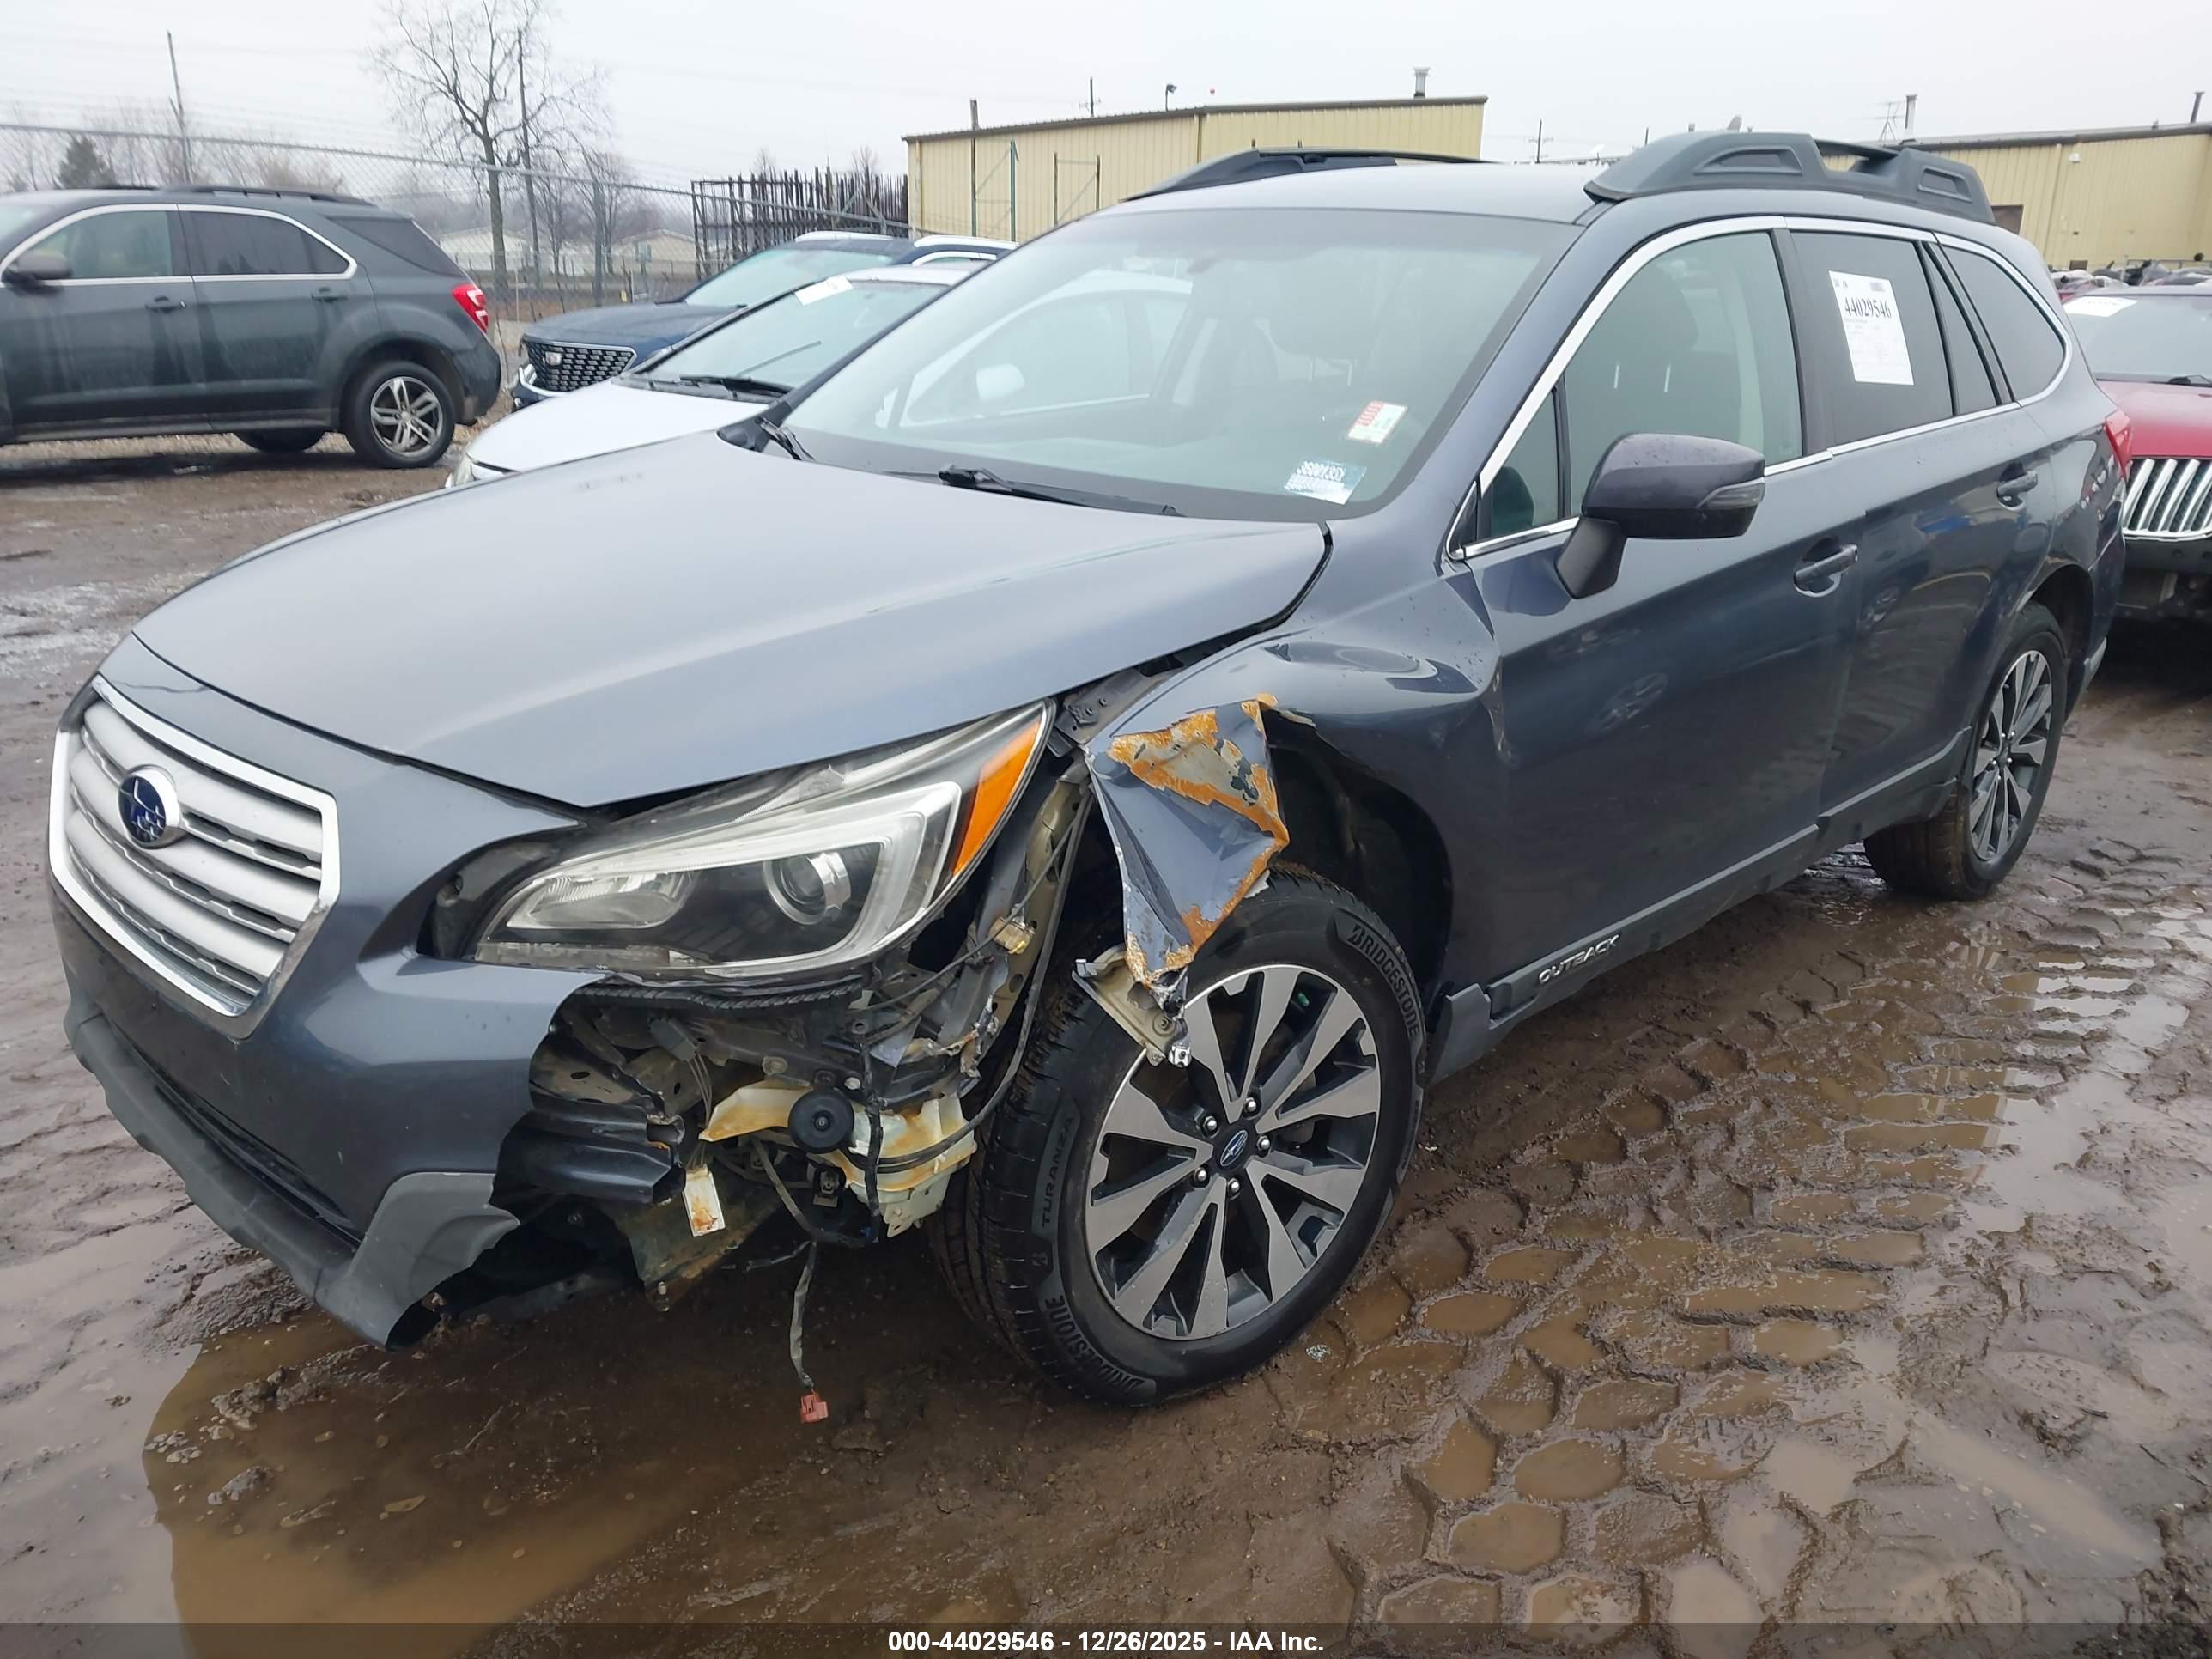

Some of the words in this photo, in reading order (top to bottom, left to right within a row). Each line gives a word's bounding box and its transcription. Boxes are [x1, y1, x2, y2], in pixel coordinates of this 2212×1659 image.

[1844, 297, 1892, 318] 44029546
[1347, 923, 1420, 1038] BRIDGESTONE
[1042, 1118, 1073, 1227] TURANZA
